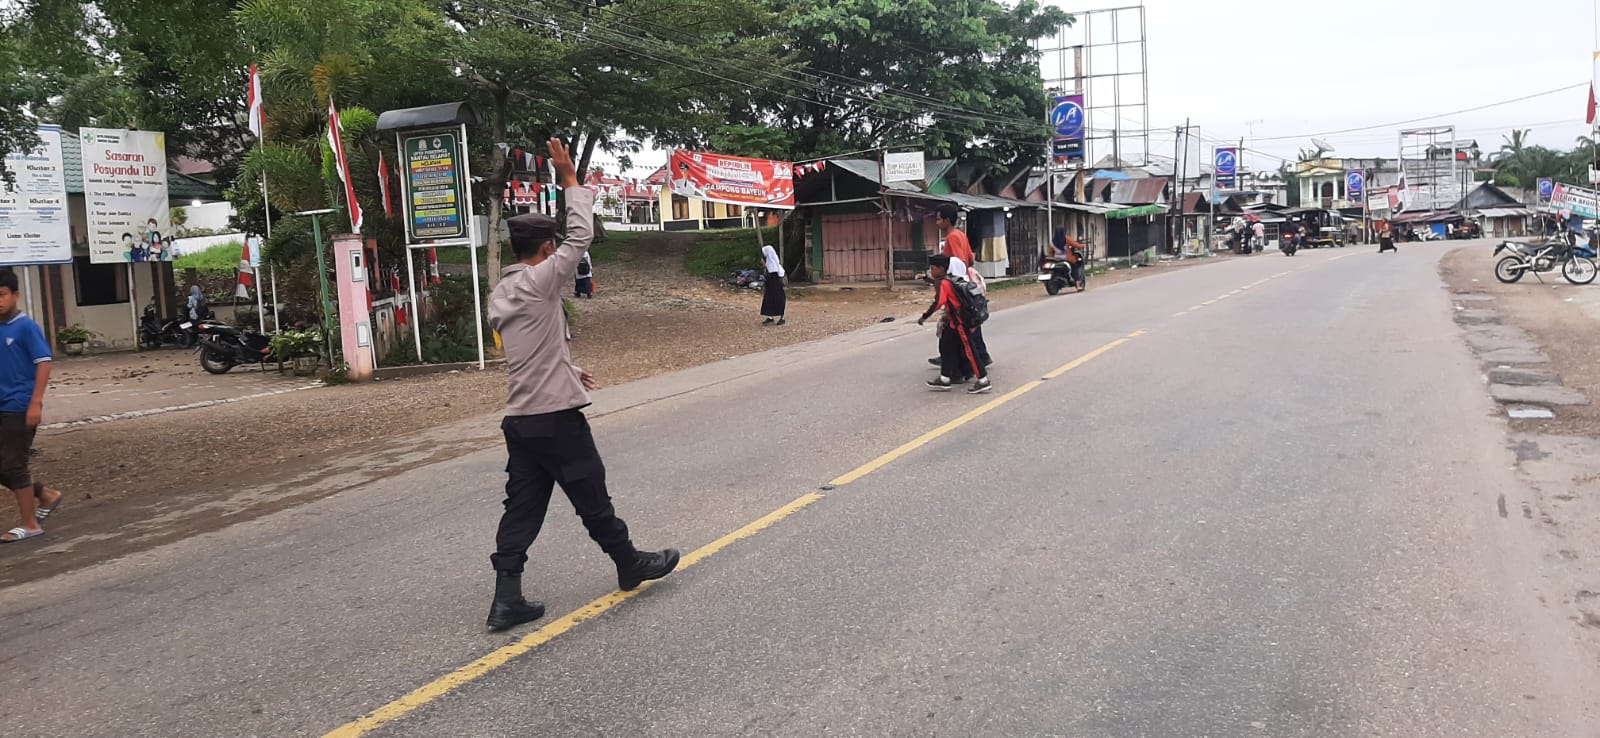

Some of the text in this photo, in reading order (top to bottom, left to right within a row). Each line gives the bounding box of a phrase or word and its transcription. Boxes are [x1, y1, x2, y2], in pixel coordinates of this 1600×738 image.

[1055, 106, 1077, 126] LA
[105, 149, 144, 162] Sasaran
[93, 163, 157, 177] Posyandu ILP
[705, 183, 740, 194] GAMPONG
